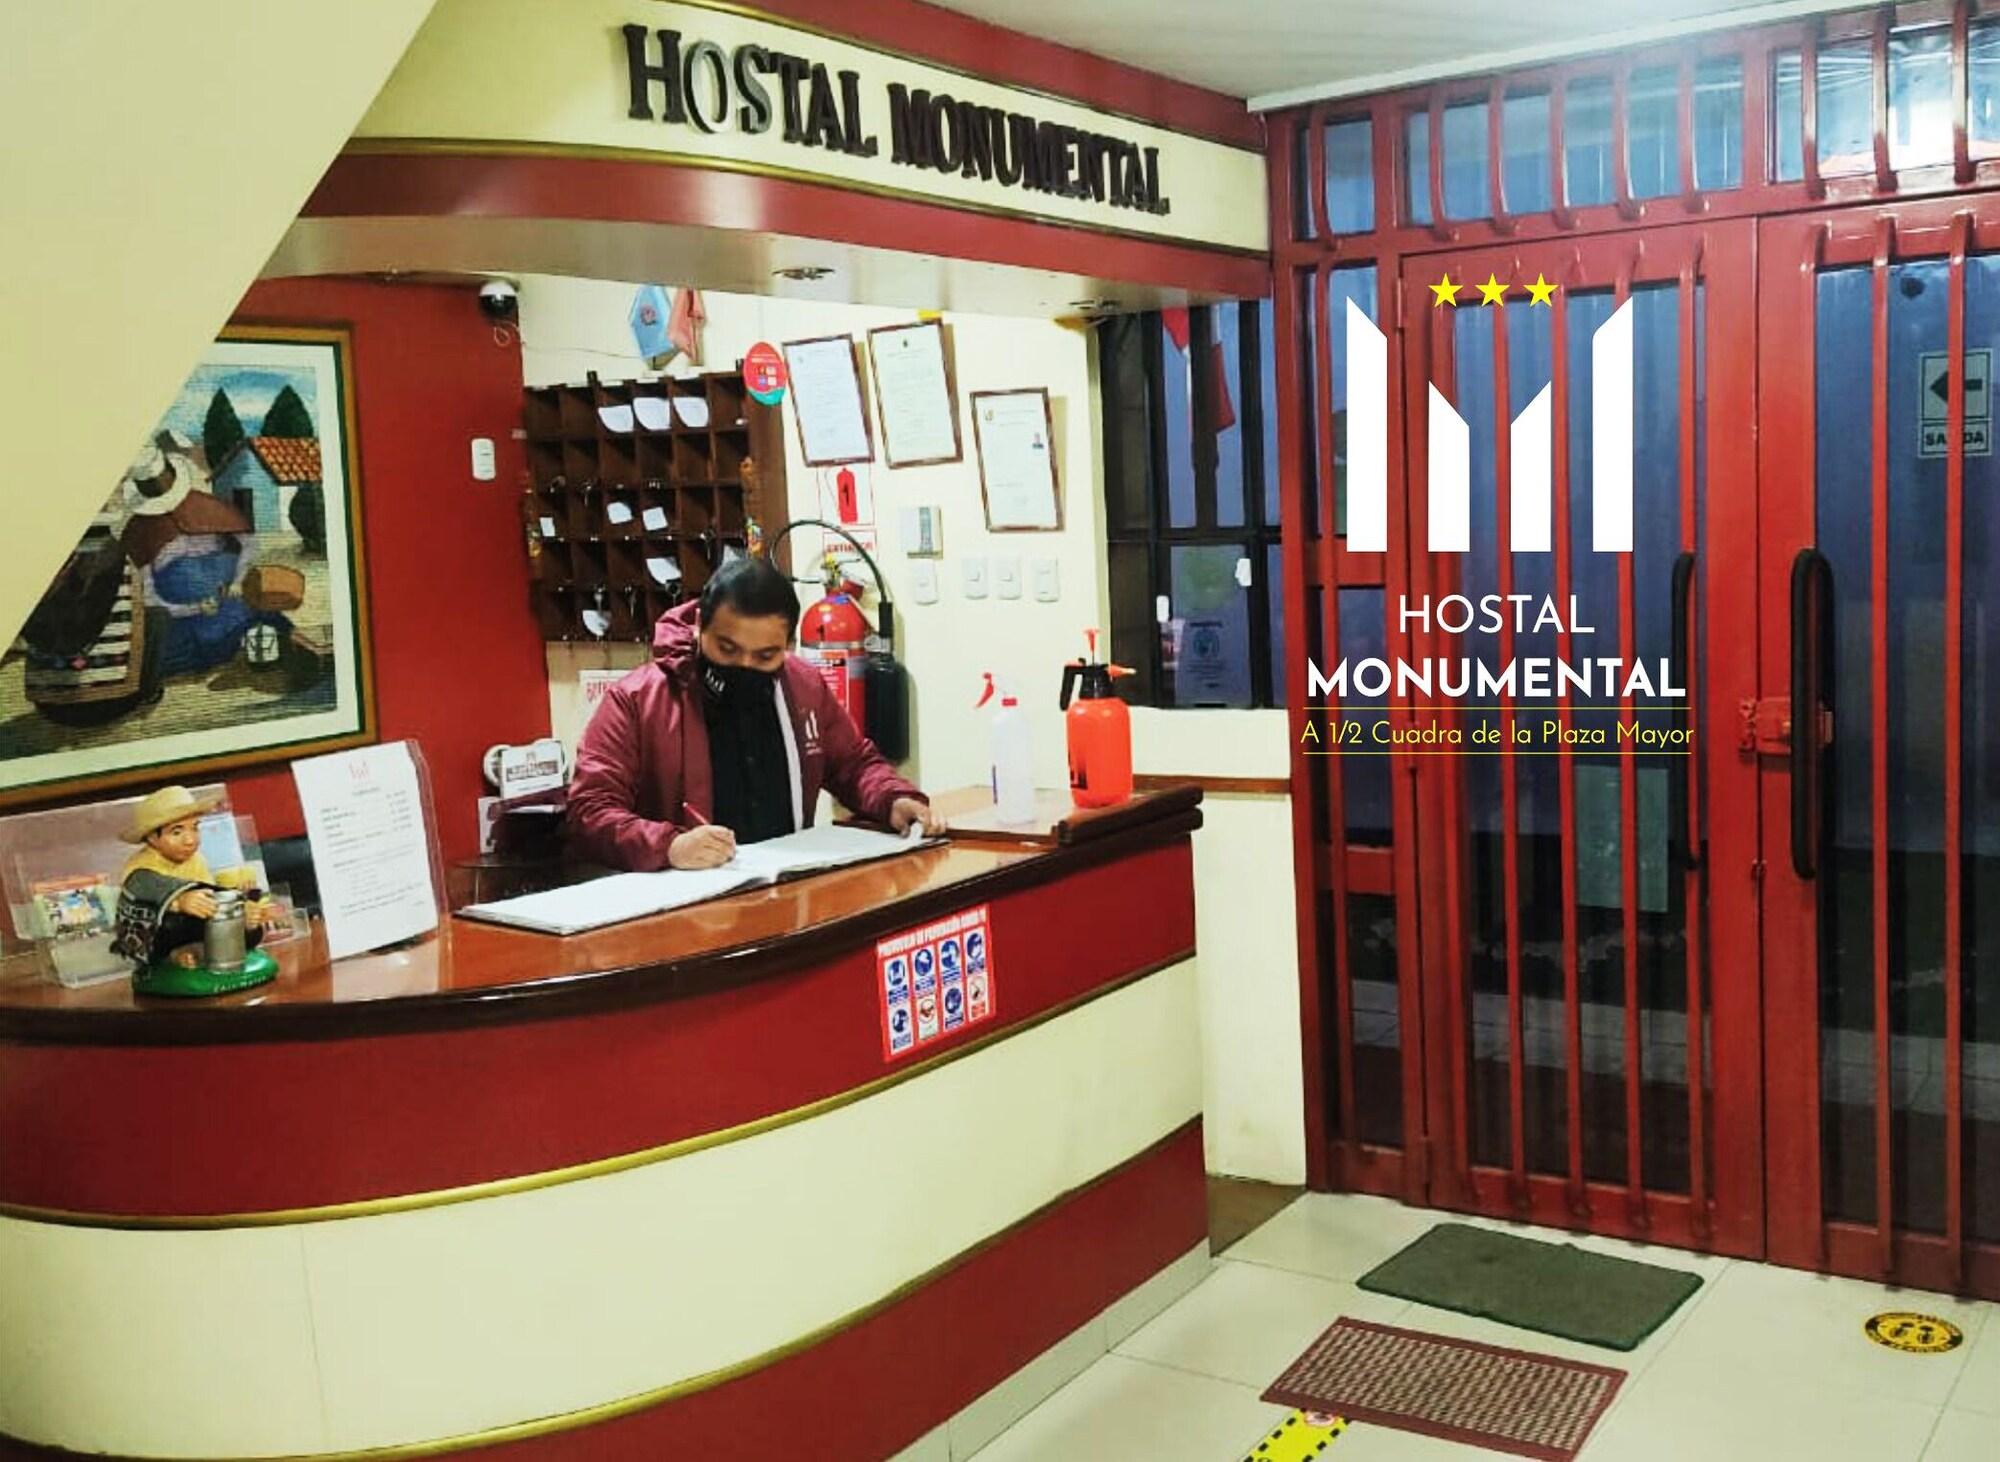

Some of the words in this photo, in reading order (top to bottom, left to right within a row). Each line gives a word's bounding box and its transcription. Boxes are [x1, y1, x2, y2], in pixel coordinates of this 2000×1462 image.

[622, 24, 879, 158] HOSTAL
[887, 83, 1171, 216] MONUMENTAL
[1925, 431, 1985, 446] SADA
